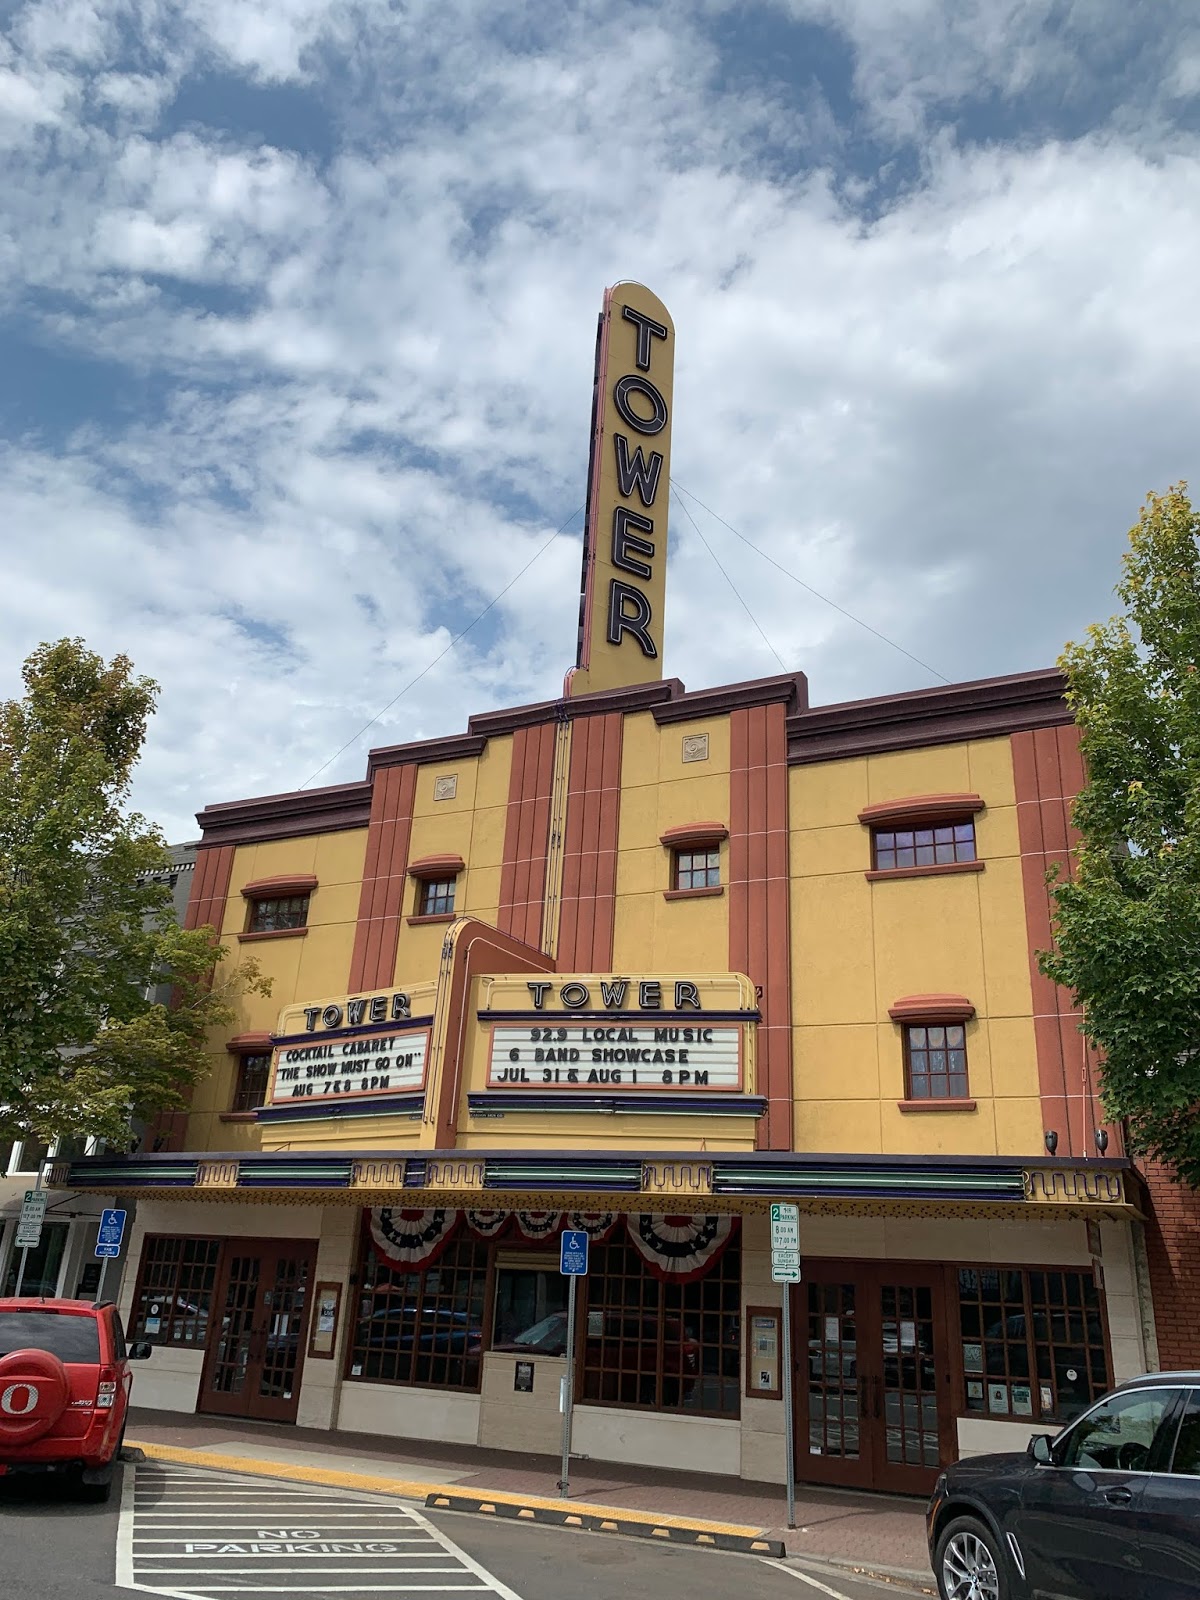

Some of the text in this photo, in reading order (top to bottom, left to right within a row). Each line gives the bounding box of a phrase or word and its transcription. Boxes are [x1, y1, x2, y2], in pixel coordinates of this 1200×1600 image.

[607, 304, 668, 659] TOWER
[528, 981, 700, 1009] TOWER
[303, 993, 411, 1032] TOWER
[530, 1027, 713, 1043] 92.9 LOCAL MUSIC
[286, 1037, 396, 1063] COCKTAIL CABARET
[509, 1048, 689, 1063] 6 BAND SHOWCASE
[306, 1063, 338, 1079] SHOW
[341, 1058, 370, 1074] MUST
[375, 1056, 390, 1071] GO
[497, 1068, 530, 1083] JUL
[543, 1068, 559, 1083] 31
[567, 1069, 579, 1083] &
[587, 1069, 622, 1084] AUG
[292, 1082, 314, 1098] AUG
[26, 1192, 32, 1202] 2
[773, 1208, 779, 1220] 2
[1, 1383, 39, 1414] O
[257, 1530, 321, 1539] NO
[185, 1543, 398, 1553] PARKING
